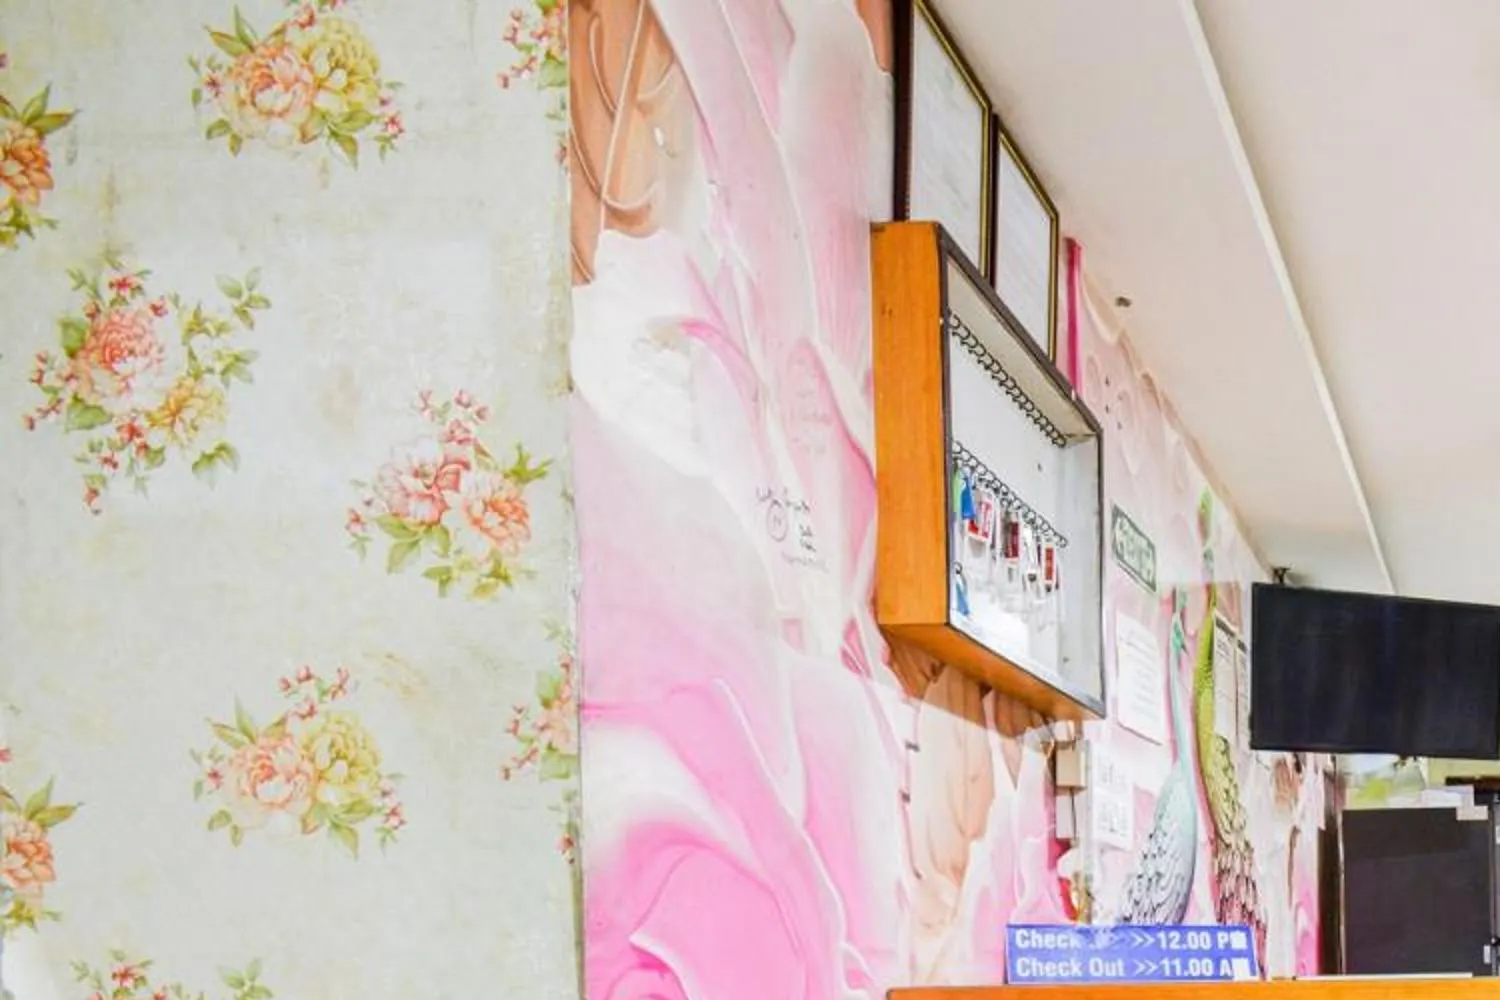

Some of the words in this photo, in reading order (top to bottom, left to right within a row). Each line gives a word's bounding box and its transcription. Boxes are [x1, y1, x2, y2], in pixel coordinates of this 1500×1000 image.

[1015, 929, 1083, 949] Check
[1016, 957, 1083, 977] Check
[1089, 957, 1125, 977] Out
[1219, 957, 1250, 977] A
